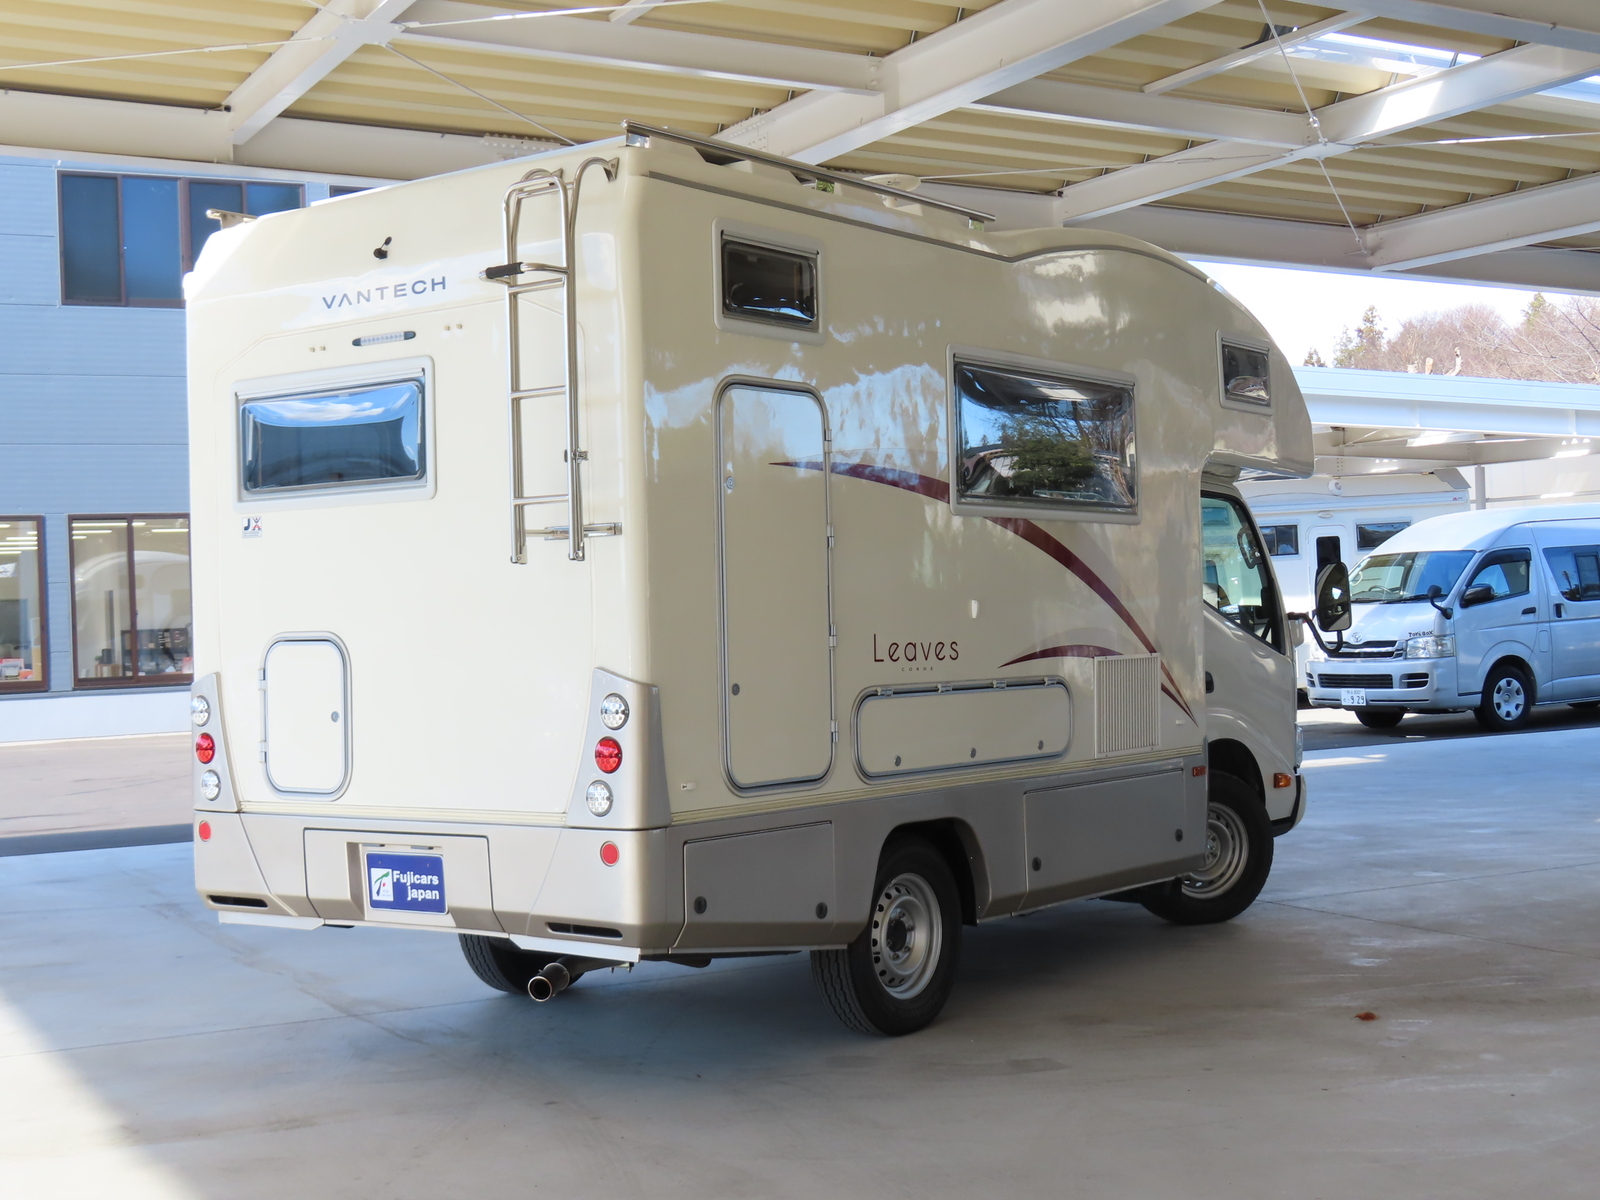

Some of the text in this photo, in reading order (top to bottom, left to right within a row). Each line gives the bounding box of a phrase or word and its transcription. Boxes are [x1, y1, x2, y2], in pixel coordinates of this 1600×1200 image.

[322, 276, 446, 309] VANTECH
[873, 633, 959, 662] Leaves
[393, 870, 439, 886] Fujicars
[407, 886, 440, 901] japan
